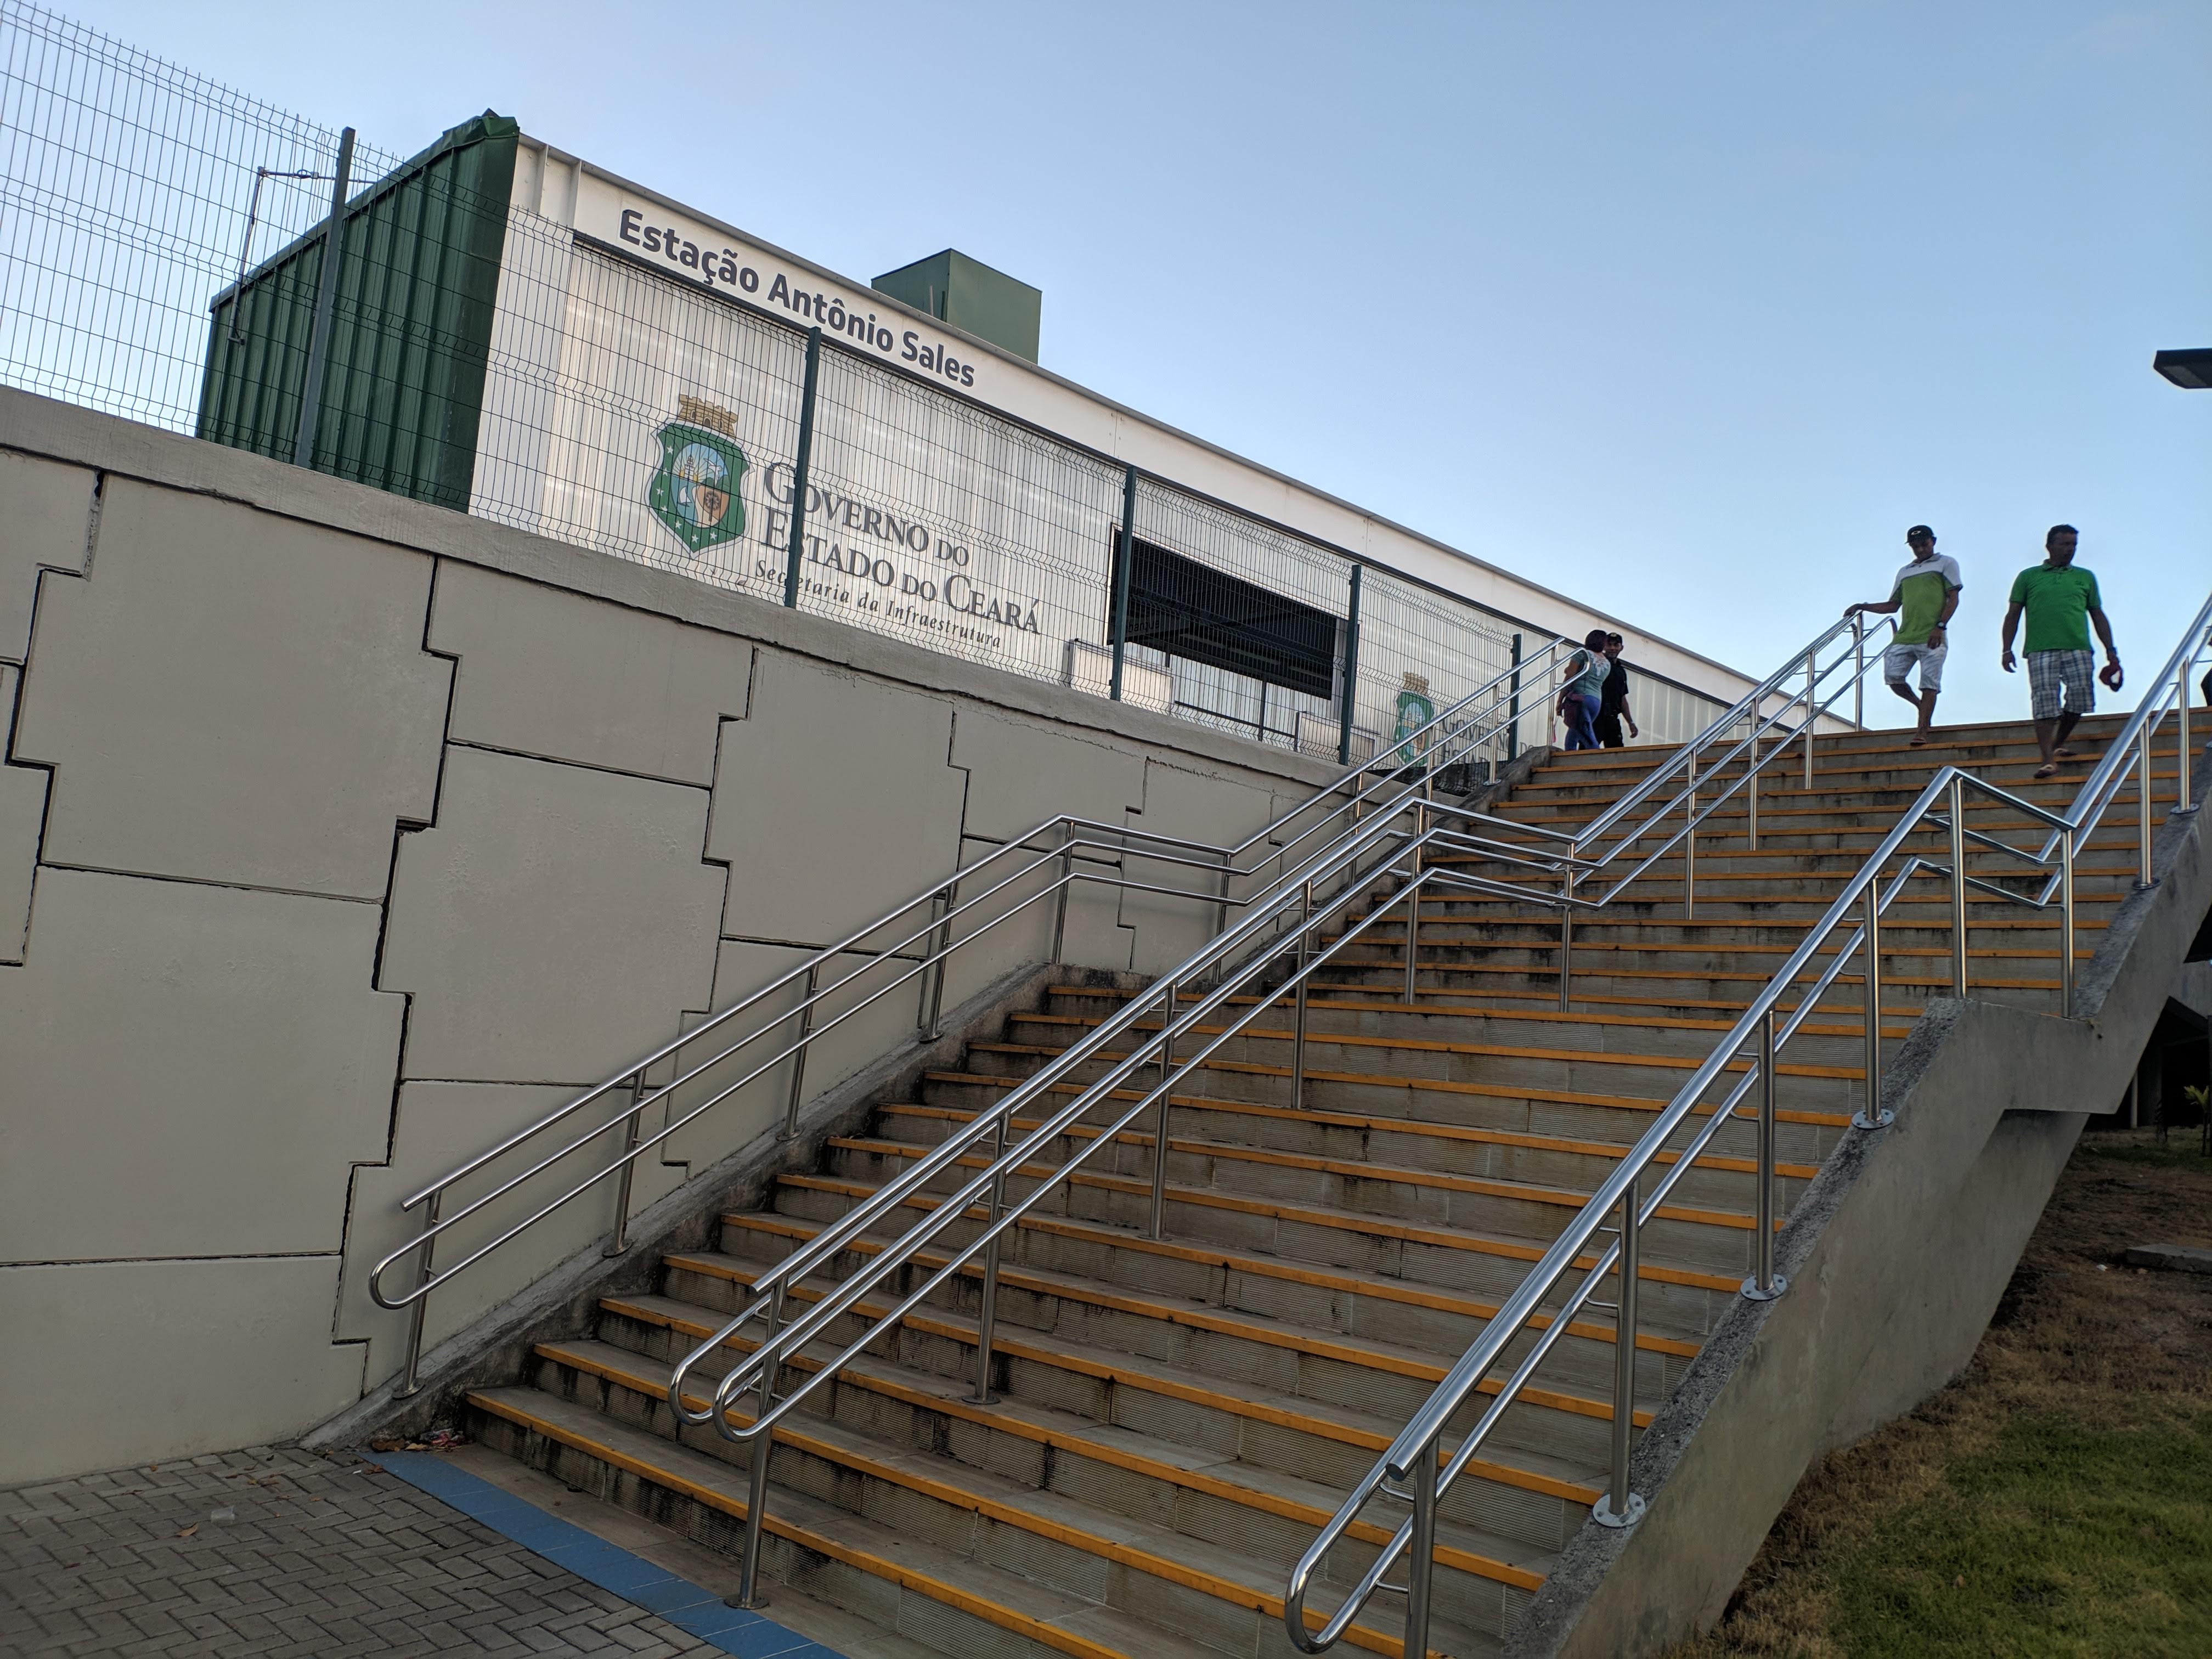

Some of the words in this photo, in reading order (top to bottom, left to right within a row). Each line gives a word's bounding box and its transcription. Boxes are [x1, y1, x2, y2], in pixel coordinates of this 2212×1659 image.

[619, 209, 759, 294] Estação
[768, 273, 893, 353] Antônio
[901, 331, 974, 387] Sales
[760, 506, 895, 587] ETADO
[901, 573, 936, 601] DO
[945, 574, 1040, 635] CEARÁ
[765, 462, 929, 552] GOVERNO
[935, 539, 969, 567] DO
[756, 560, 849, 603] Secetaria
[858, 591, 878, 612] da
[886, 600, 1001, 648] Infraestrutura
